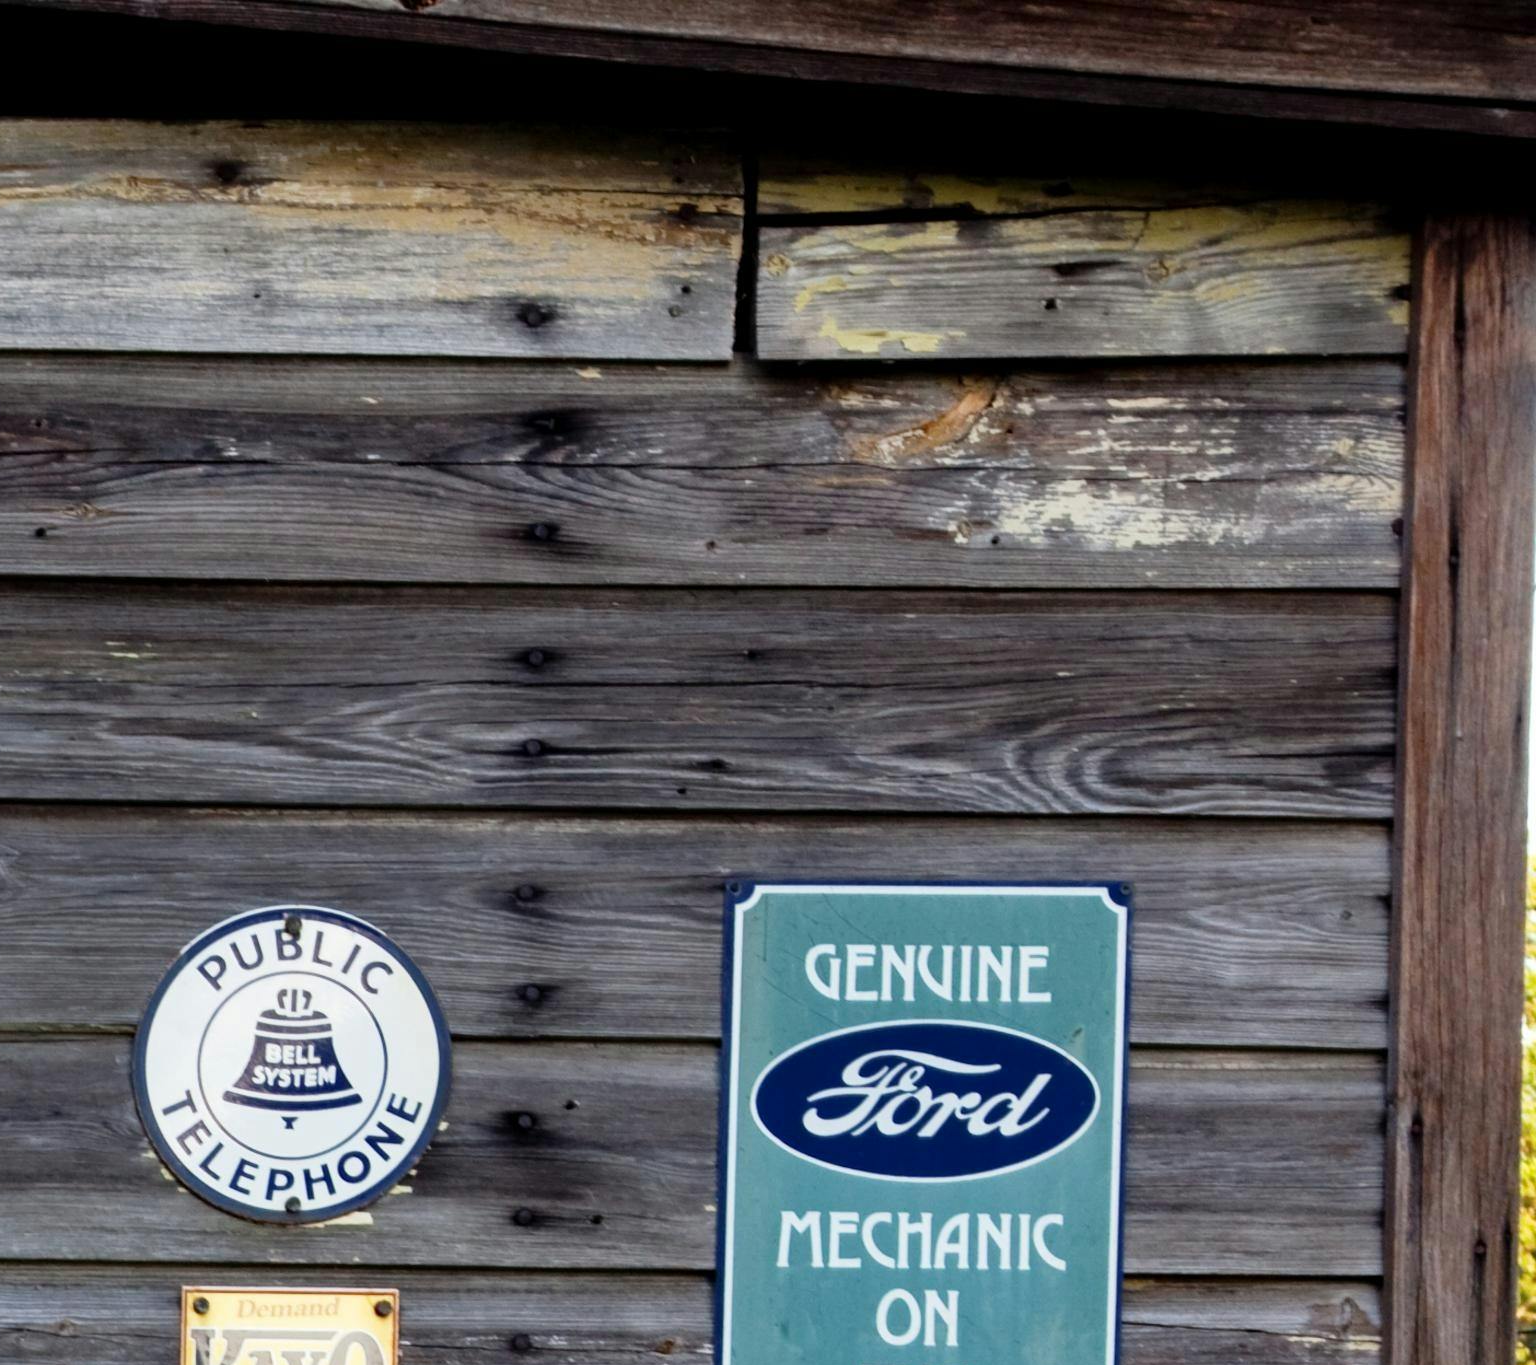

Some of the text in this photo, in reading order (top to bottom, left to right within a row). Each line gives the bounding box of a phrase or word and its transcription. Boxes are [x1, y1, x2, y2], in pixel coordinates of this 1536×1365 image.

[195, 928, 394, 995] PUBLIC
[803, 943, 1053, 1003] GENUINE
[251, 1065, 338, 1088] SYSTEM
[264, 1044, 322, 1066] BELL
[801, 1049, 1053, 1139] Ford
[162, 1089, 424, 1201] TELEPHONE
[775, 1210, 1068, 1272] MECHANIC
[235, 1298, 340, 1318] Demand
[874, 1288, 960, 1347] ON
